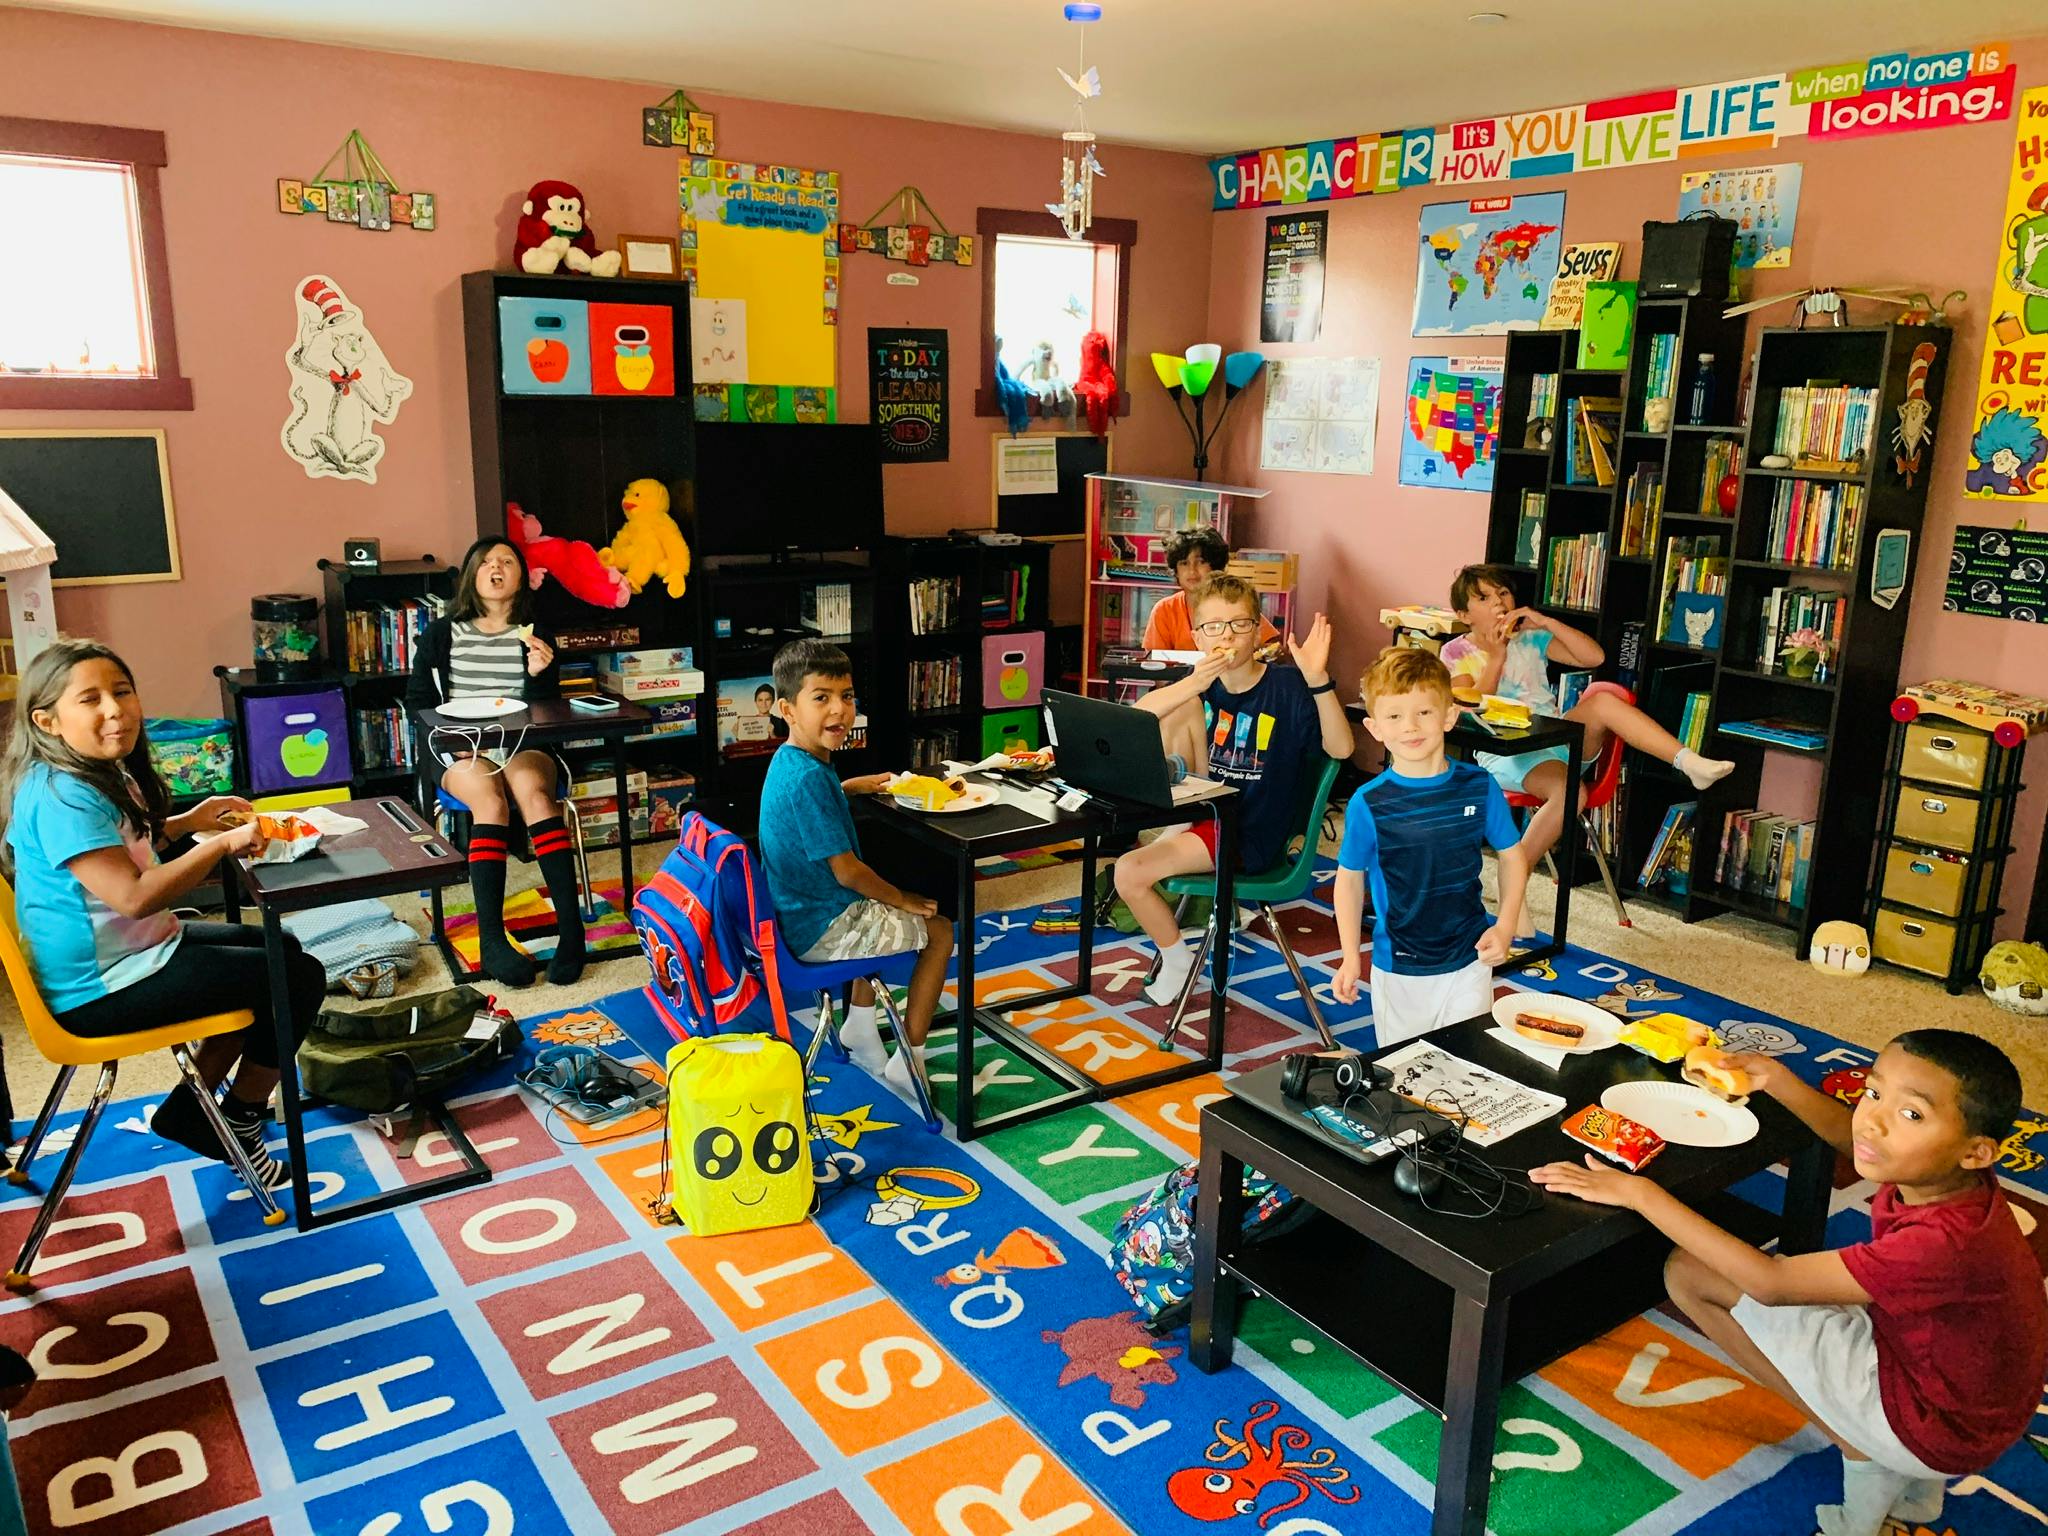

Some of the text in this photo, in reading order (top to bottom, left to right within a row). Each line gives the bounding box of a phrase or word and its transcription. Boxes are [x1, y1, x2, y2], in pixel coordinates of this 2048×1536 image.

[1795, 46, 2000, 99] when no one is
[1679, 79, 1781, 142] LIFE
[1821, 86, 2004, 133] looking.
[1461, 125, 1490, 148] It's
[1503, 109, 1578, 159] YOU
[1581, 112, 1676, 168] LIVE
[2018, 134, 2048, 169] H
[1217, 134, 1431, 203] CHARACTER
[1440, 149, 1506, 182] HOW
[724, 183, 748, 200] Get
[750, 187, 786, 206] Ready
[787, 193, 796, 205] to
[1473, 199, 1508, 210] THE WORLD
[1270, 221, 1307, 237] we are
[1295, 240, 1316, 250] GRAND
[1558, 246, 1614, 279] Seuss
[1552, 305, 1573, 319] DAY!
[877, 349, 941, 366] TODAY
[889, 367, 929, 382] the day to
[1990, 349, 2048, 387] RE
[877, 381, 942, 402] LEARN
[878, 403, 941, 424] SOMETHING
[894, 423, 928, 441] NEW
[1089, 957, 1152, 993] K
[1576, 961, 1630, 985] D
[1054, 1029, 1150, 1073] R
[412, 1130, 520, 1169] P
[1037, 1123, 1141, 1167] Y
[17, 1210, 147, 1275] D
[459, 1196, 578, 1255] O
[894, 1210, 972, 1257] R
[259, 1262, 386, 1307] I
[715, 1249, 834, 1310] T
[948, 1272, 1026, 1330] Q
[27, 1310, 171, 1382] C
[523, 1292, 673, 1377] N
[815, 1334, 944, 1411] S
[1612, 1342, 1748, 1410] V
[297, 1354, 457, 1451] H
[589, 1390, 760, 1506] M
[1080, 1408, 1174, 1458] P
[45, 1428, 210, 1530] B
[933, 1451, 1096, 1536] R
